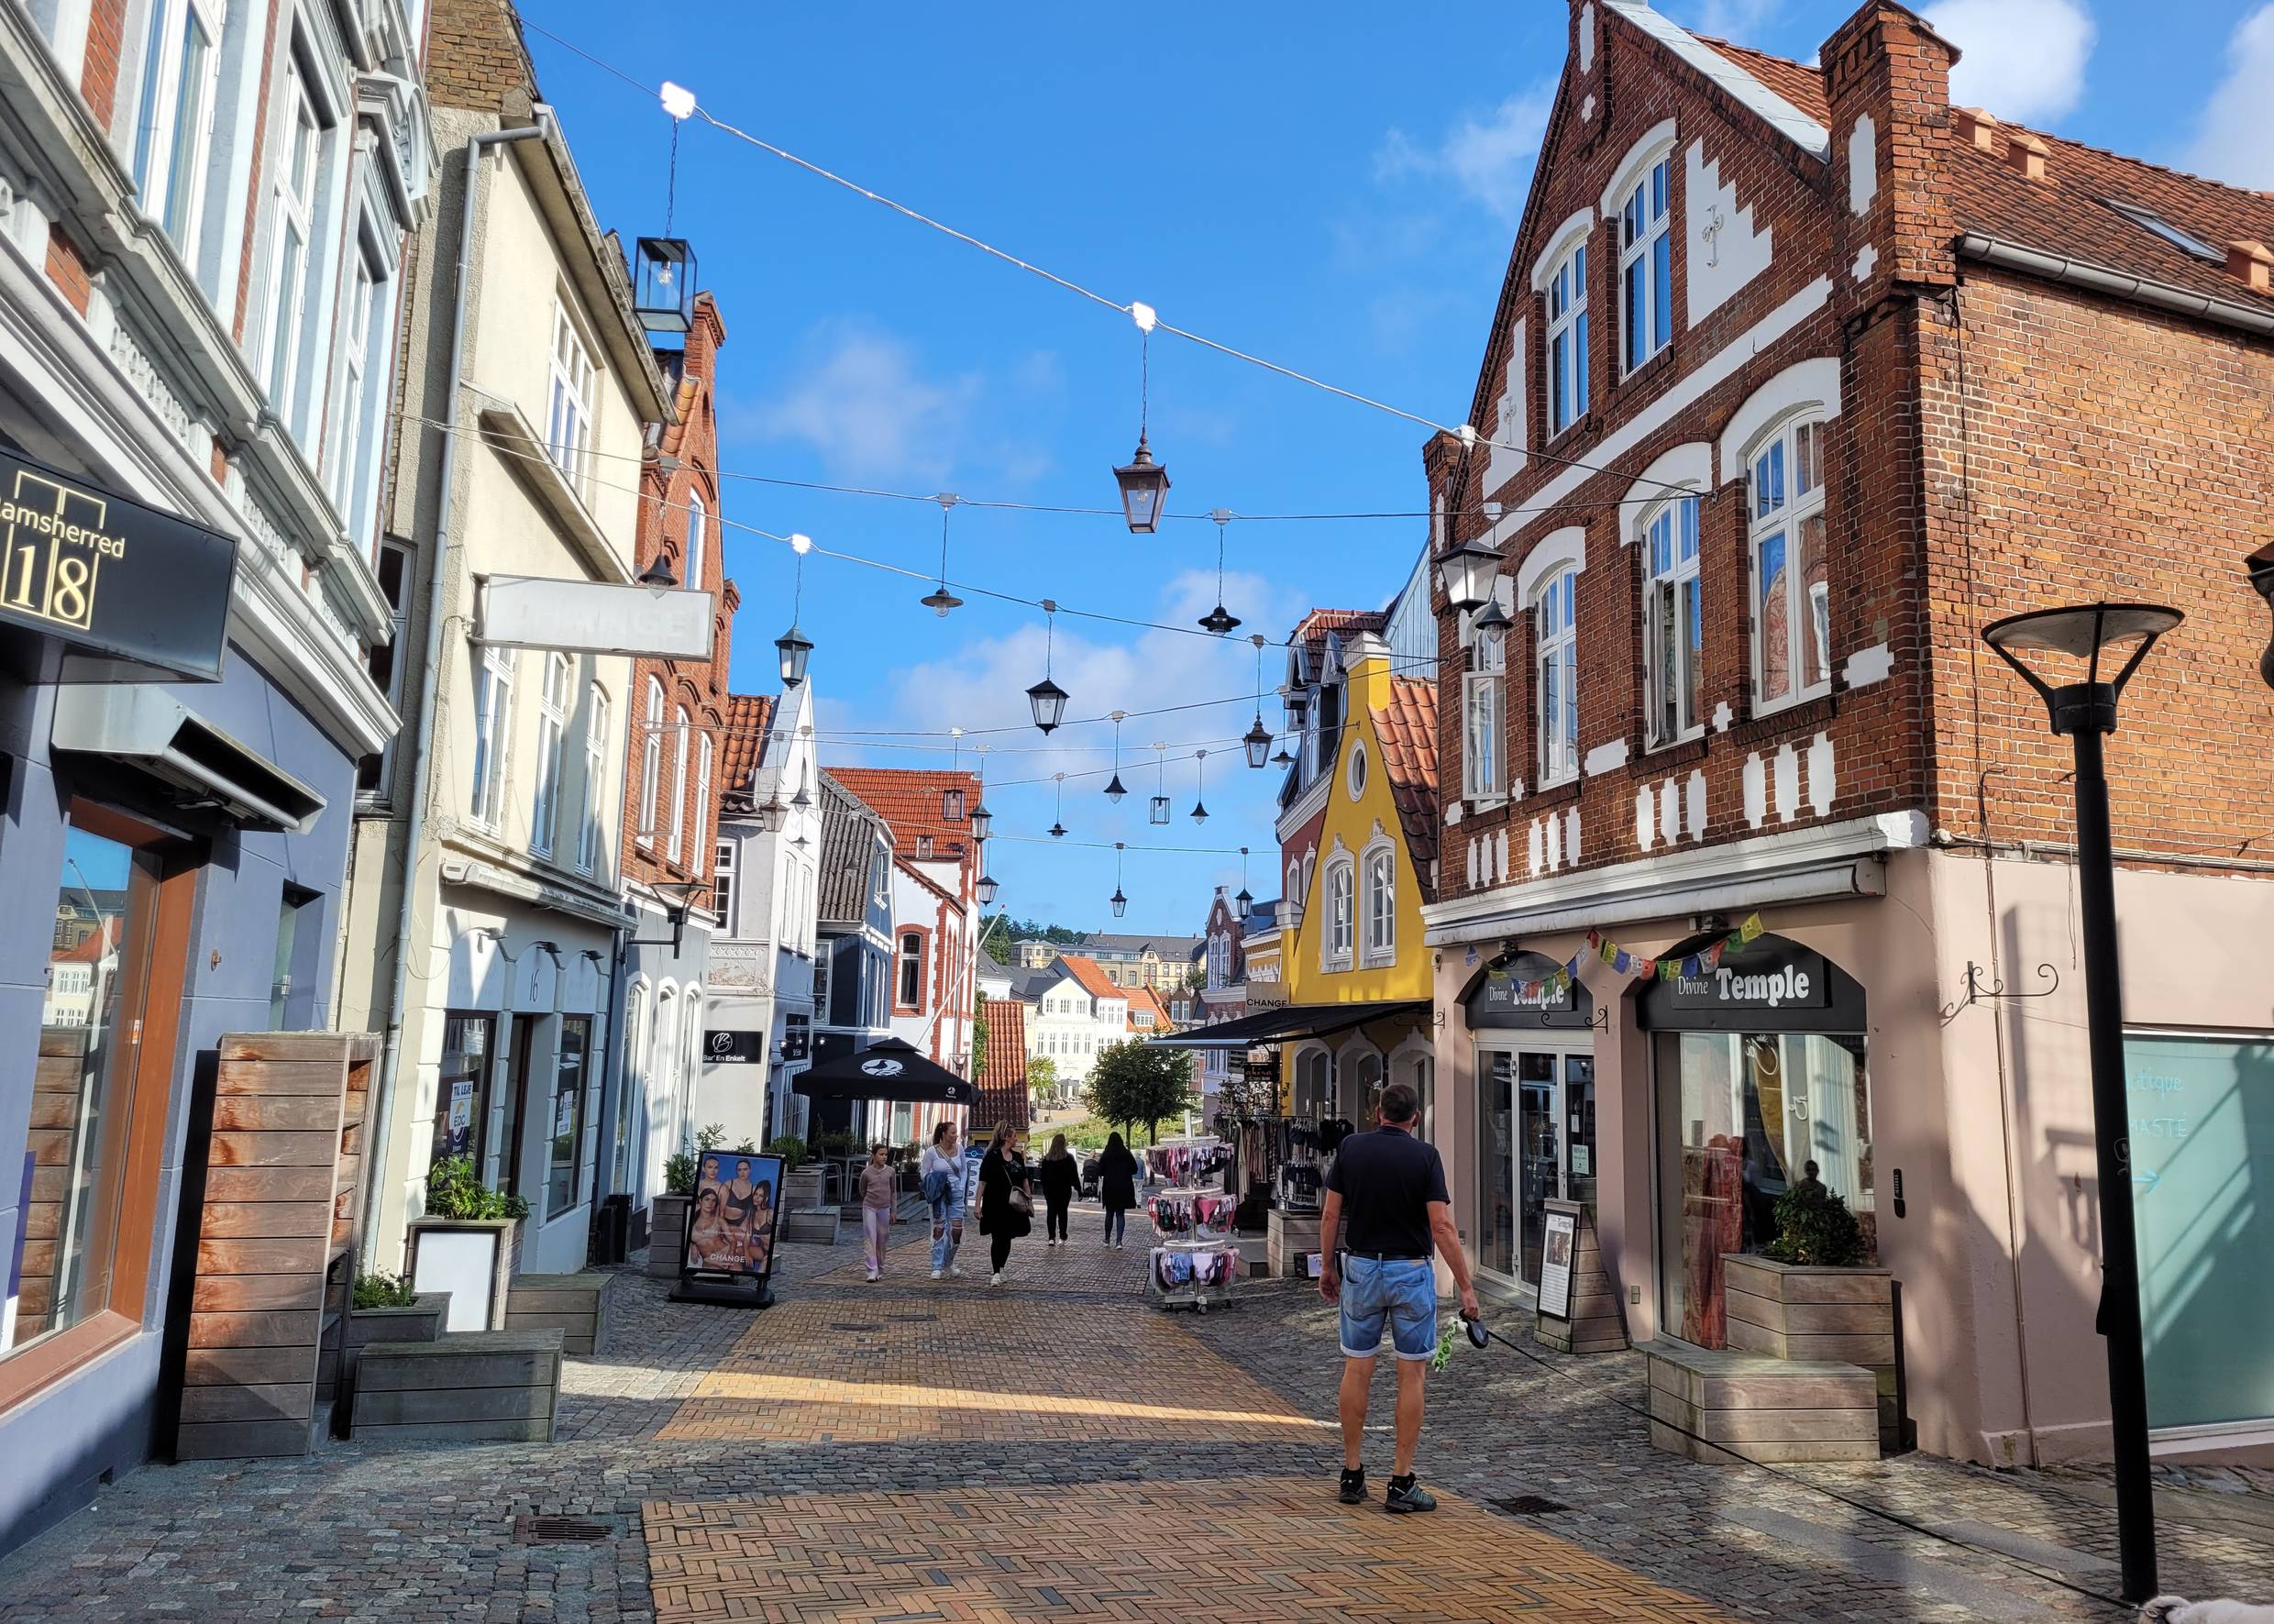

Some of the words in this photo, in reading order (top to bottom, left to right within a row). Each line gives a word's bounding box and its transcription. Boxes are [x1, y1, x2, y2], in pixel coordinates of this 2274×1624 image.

[0, 496, 126, 558] amsherred
[11, 545, 88, 619] 18
[529, 968, 539, 1002] 16
[1489, 986, 1507, 1001] Divine
[1677, 976, 1709, 995] Divine
[1716, 964, 1810, 1007] Temple
[460, 1083, 472, 1096] LEJE
[453, 1114, 466, 1128] EDC
[710, 1253, 746, 1263] CHANGE
